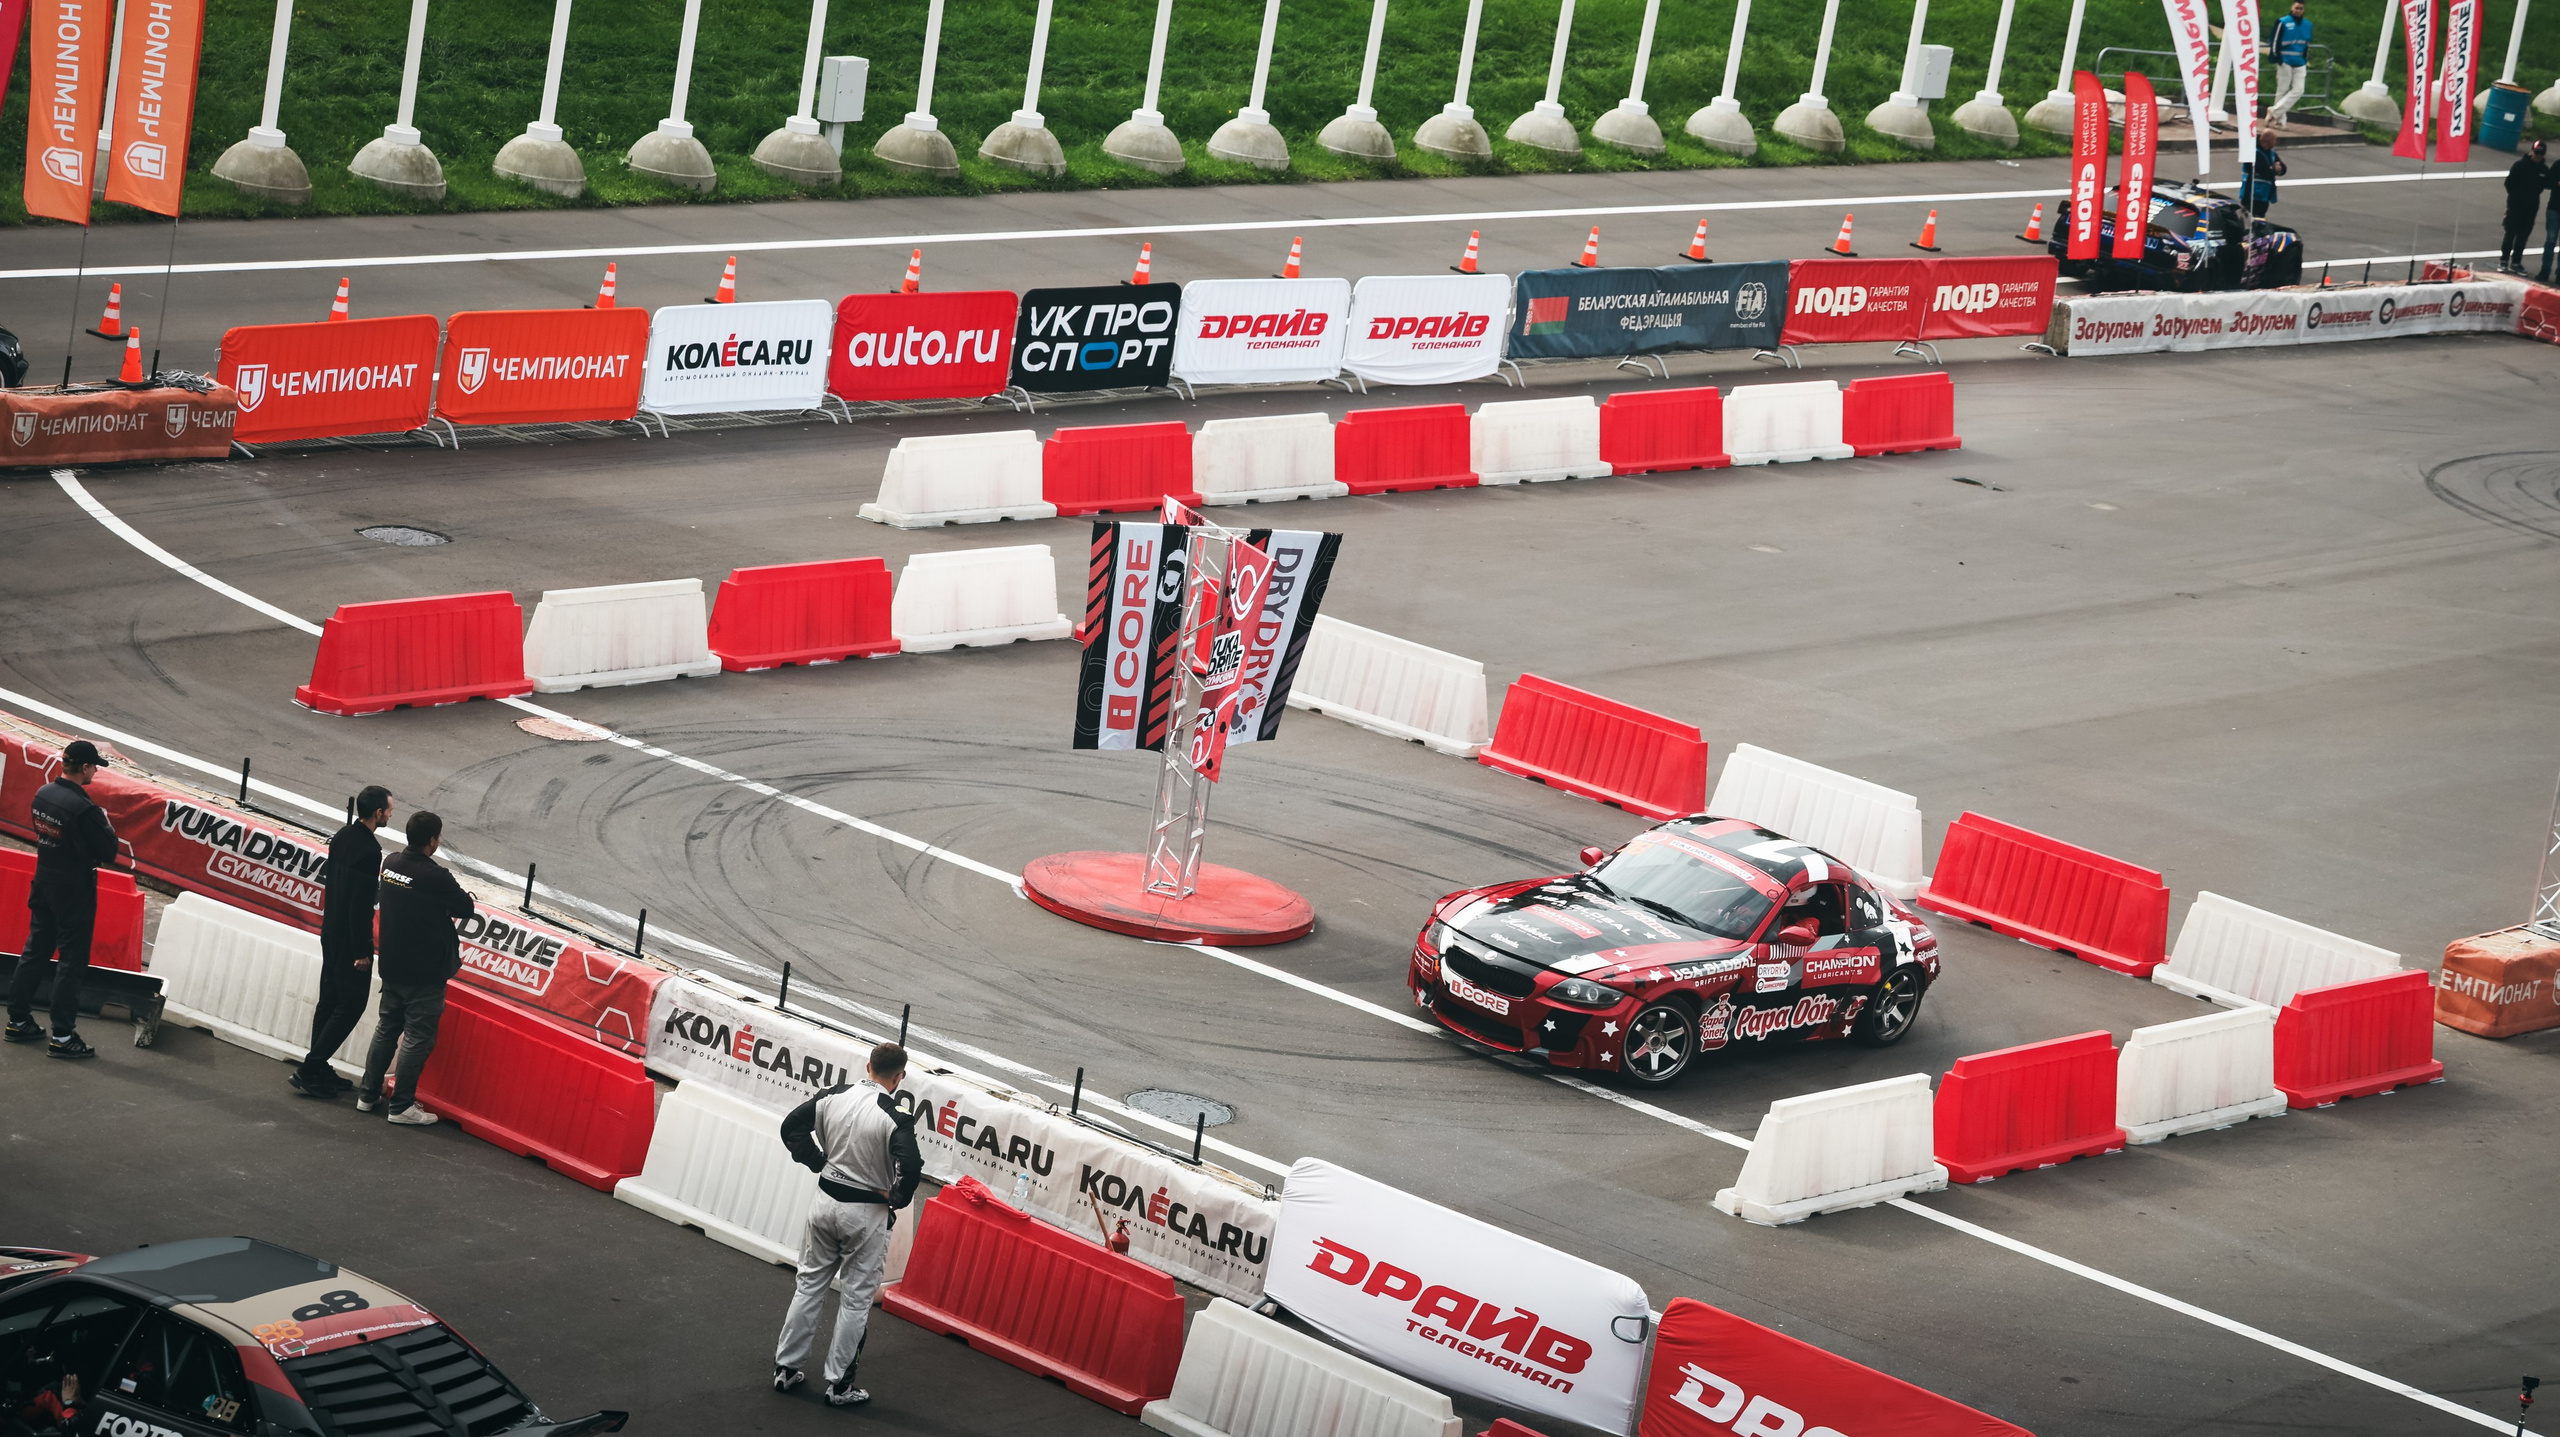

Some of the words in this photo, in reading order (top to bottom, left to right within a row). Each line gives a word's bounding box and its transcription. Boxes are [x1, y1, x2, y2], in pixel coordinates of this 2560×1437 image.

[1869, 285, 1909, 297] ГАРАНТИЯ
[1933, 283, 2000, 314] ЛОДЭ
[2001, 282, 2039, 293] ГАРАНТИЯ
[1578, 294, 1646, 311] БЕЛАРУСКАЯ
[1795, 286, 1867, 317] ЛОДЭ
[1867, 301, 1908, 312] КАЧЕСТВА
[1999, 296, 2037, 308] КАЧЕСТВА
[1030, 305, 1083, 338] VK
[1085, 301, 1173, 337] ПРО
[1198, 308, 1329, 339] ДРАЙВ
[1366, 311, 1490, 340] ДРАЙВ
[1620, 313, 1682, 332] ФЕДЭРАЦЫЯ
[848, 325, 1000, 367] auto.ru
[1020, 338, 1169, 371] СПОРТ
[272, 364, 418, 397] ЧЕМПИОНАТ
[492, 355, 629, 381] ЧЕМПИОНАТ
[664, 371, 736, 382] АВТОМОБИЛЬНЫЙ
[742, 369, 809, 378] ОНЛАЙН-ЖУРНАЛ
[40, 413, 149, 436] ЧЕМПИОНАТ
[1212, 634, 1239, 658] YUKA
[1208, 650, 1242, 675] DRIVE
[165, 801, 246, 853] YUKA
[217, 855, 322, 907] GYMKHANA
[383, 868, 413, 884] FORSE
[456, 914, 563, 968] DRIVE
[458, 942, 539, 987] MKHANA
[1669, 965, 1703, 981] USA
[1703, 955, 1756, 976] GLOBAL
[1759, 965, 1782, 976] DRYDRY
[1806, 955, 1876, 973] CHAMPION
[1813, 969, 1863, 980] LUBRICANTS
[1695, 977, 1716, 987] DRIFT
[1720, 973, 1739, 982] TEAM
[1701, 1014, 1725, 1028] Papa
[1736, 1005, 1792, 1041] Papa
[662, 1038, 750, 1076] АВТОМОБИЛЬНЫЙ
[757, 1073, 816, 1097] ОНЛАЙН-Ж
[960, 1151, 1049, 1191] ОНЛАЙН-ЖНАЛ
[1174, 1238, 1262, 1280] ОНЛАЙН-ЖУРНАЛ
[1305, 1236, 1593, 1374] ДРАЙВ
[252, 1319, 304, 1344] 88
[1405, 1318, 1574, 1394] ТЕЛЕКАНАЛ
